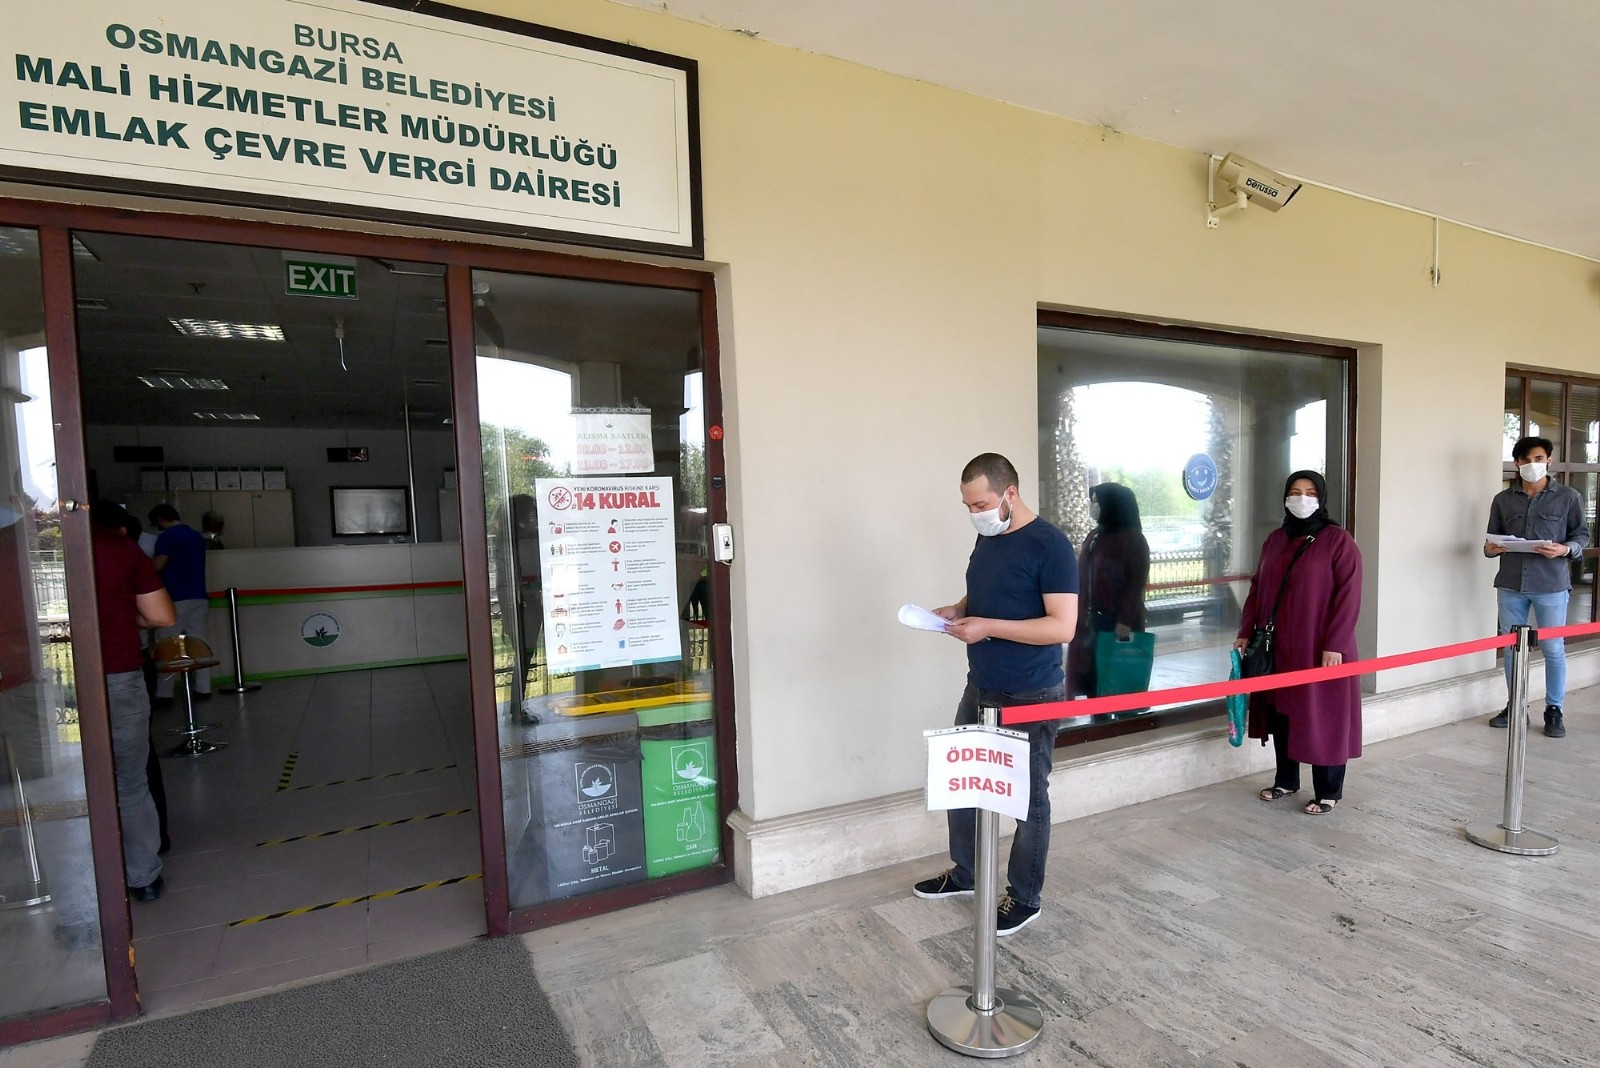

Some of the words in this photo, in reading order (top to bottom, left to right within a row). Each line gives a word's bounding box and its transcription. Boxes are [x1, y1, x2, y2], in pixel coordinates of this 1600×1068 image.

[294, 23, 404, 64] BURSA
[106, 23, 348, 86] OSMANGAZİ
[361, 66, 556, 122] BELEDİYESİ
[15, 53, 131, 97] MALİ
[149, 73, 389, 135] HİZMETLER
[400, 113, 617, 170] MÜDÜRLÜĞÜ
[19, 100, 191, 150] EMLAK
[204, 126, 347, 170] ÇEVRE
[358, 147, 476, 187] VERGİ
[489, 167, 621, 208] DAİRESİ
[1245, 177, 1279, 198] berussa
[288, 264, 355, 294] EXIT
[598, 491, 661, 509] KURAL
[946, 746, 1014, 768] ÖDEME
[948, 776, 1012, 797] SIRASI
[590, 865, 609, 874] METAL
